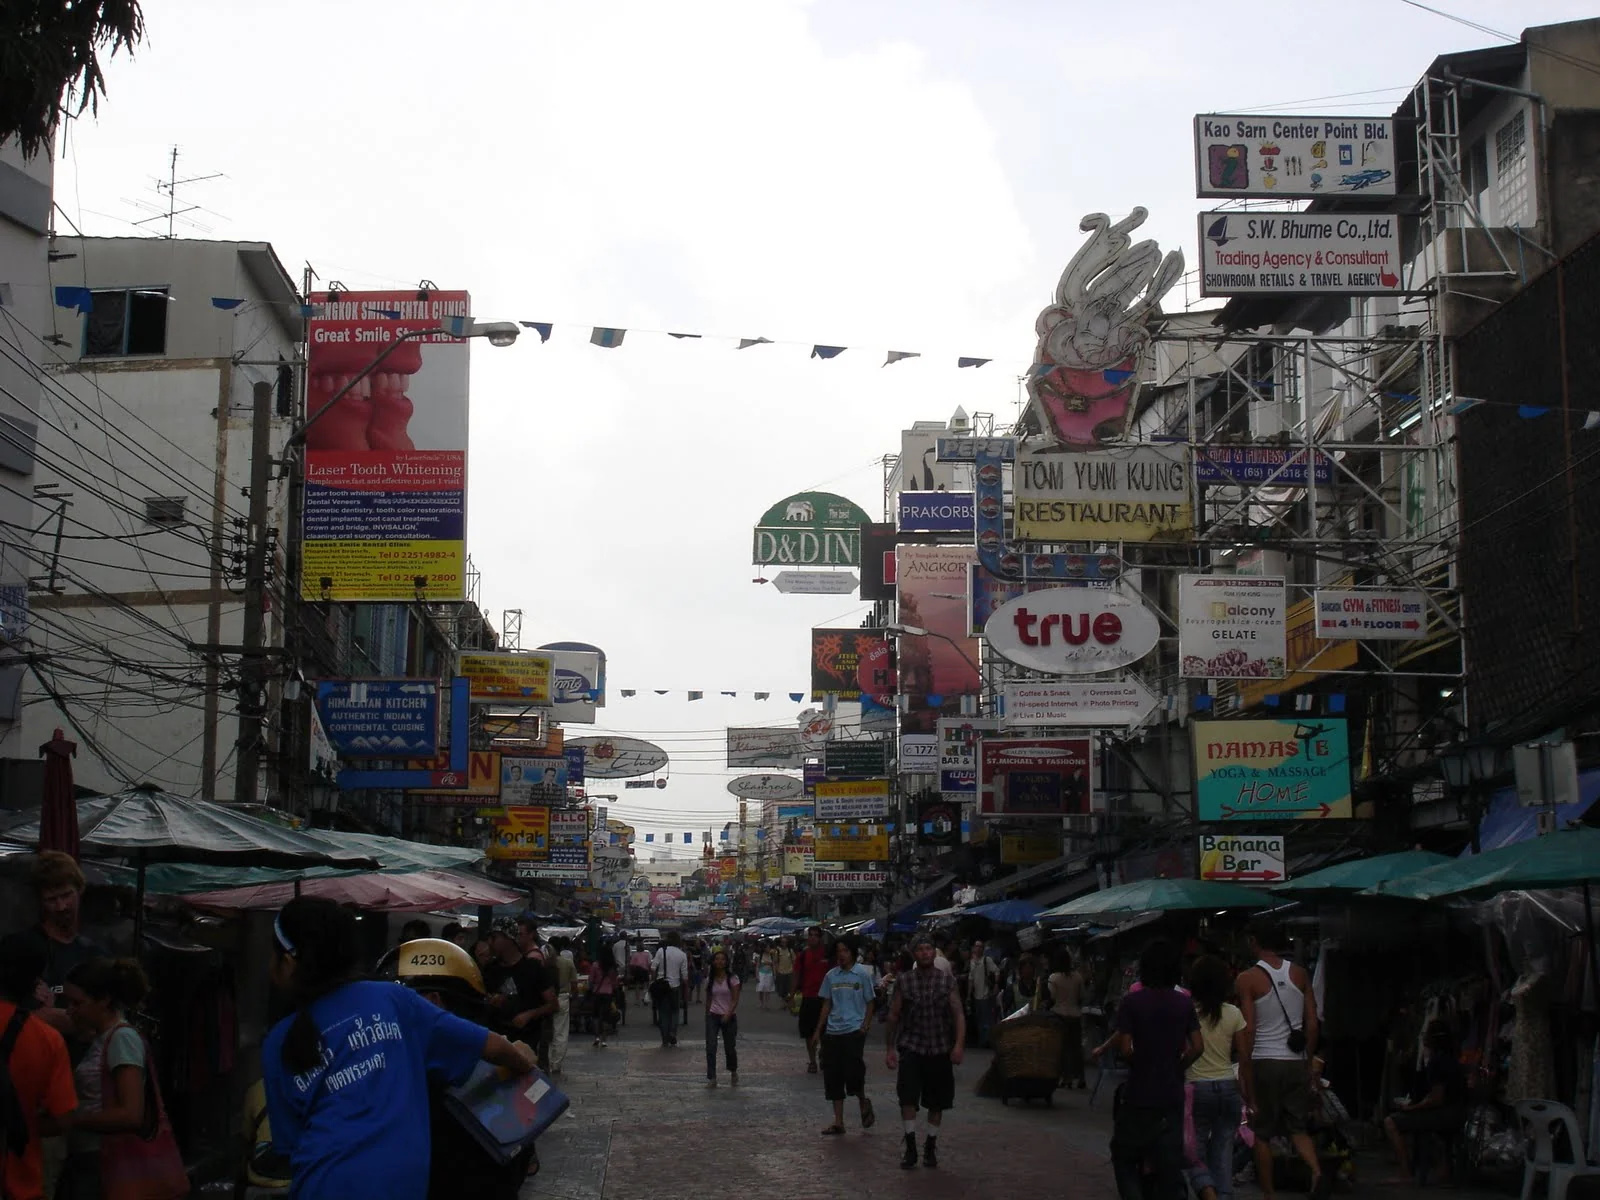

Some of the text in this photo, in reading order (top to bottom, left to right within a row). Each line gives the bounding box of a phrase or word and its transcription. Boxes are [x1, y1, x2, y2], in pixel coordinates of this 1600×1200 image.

[1204, 121, 1389, 143] Kao Sarn Center Point Bld.
[1247, 220, 1276, 239] S.W.
[1215, 251, 1389, 270] Trading Agency & Consultant
[1206, 273, 1381, 288] SHOWROOM RETAILS & TRAVEL AGENCY
[315, 328, 350, 343] Great
[355, 327, 390, 342] Smile
[943, 440, 1010, 458] PEPSI
[309, 463, 462, 477] Laser Tooth Whitening
[1021, 460, 1184, 492] TOM YUM KUNG
[350, 490, 385, 498] whitening
[1019, 501, 1182, 524] RESTAURANT
[379, 551, 392, 559] Tel
[377, 573, 392, 582] Tel
[431, 574, 457, 582] 2800
[1343, 599, 1364, 614] GYM
[1366, 603, 1371, 613] &
[1372, 598, 1401, 613] FITNESS
[1014, 608, 1122, 646] true
[1364, 621, 1402, 630] FLOOR
[1212, 630, 1257, 640] GELATE
[1020, 690, 1043, 698] Coffee
[1051, 689, 1071, 698] Snack
[1090, 688, 1121, 697] Overseas
[1123, 688, 1137, 697] Call
[386, 698, 427, 709] KITCHEN
[1019, 699, 1139, 709] hi-speed Internet Photo Printing
[331, 712, 379, 721] AUTHENTIC
[384, 712, 412, 720] INDIAN
[1020, 711, 1067, 720] Live DJ Music
[330, 723, 425, 732] CONTINENTAL CUISINE
[915, 745, 938, 755] 177
[942, 757, 970, 765] BAR &
[1046, 758, 1086, 766] FASHIONS
[1210, 765, 1327, 779] YOGA & MASSAGE
[625, 781, 655, 789] PEPSI
[737, 782, 794, 793] Shamrock
[1237, 781, 1309, 805] HOME
[551, 813, 586, 822] ELLO
[494, 829, 545, 845] Kodak
[1203, 835, 1281, 852] Banana
[1223, 854, 1262, 871] Bar
[817, 872, 888, 882] INTERNET CAFE
[411, 954, 446, 967] 4230
